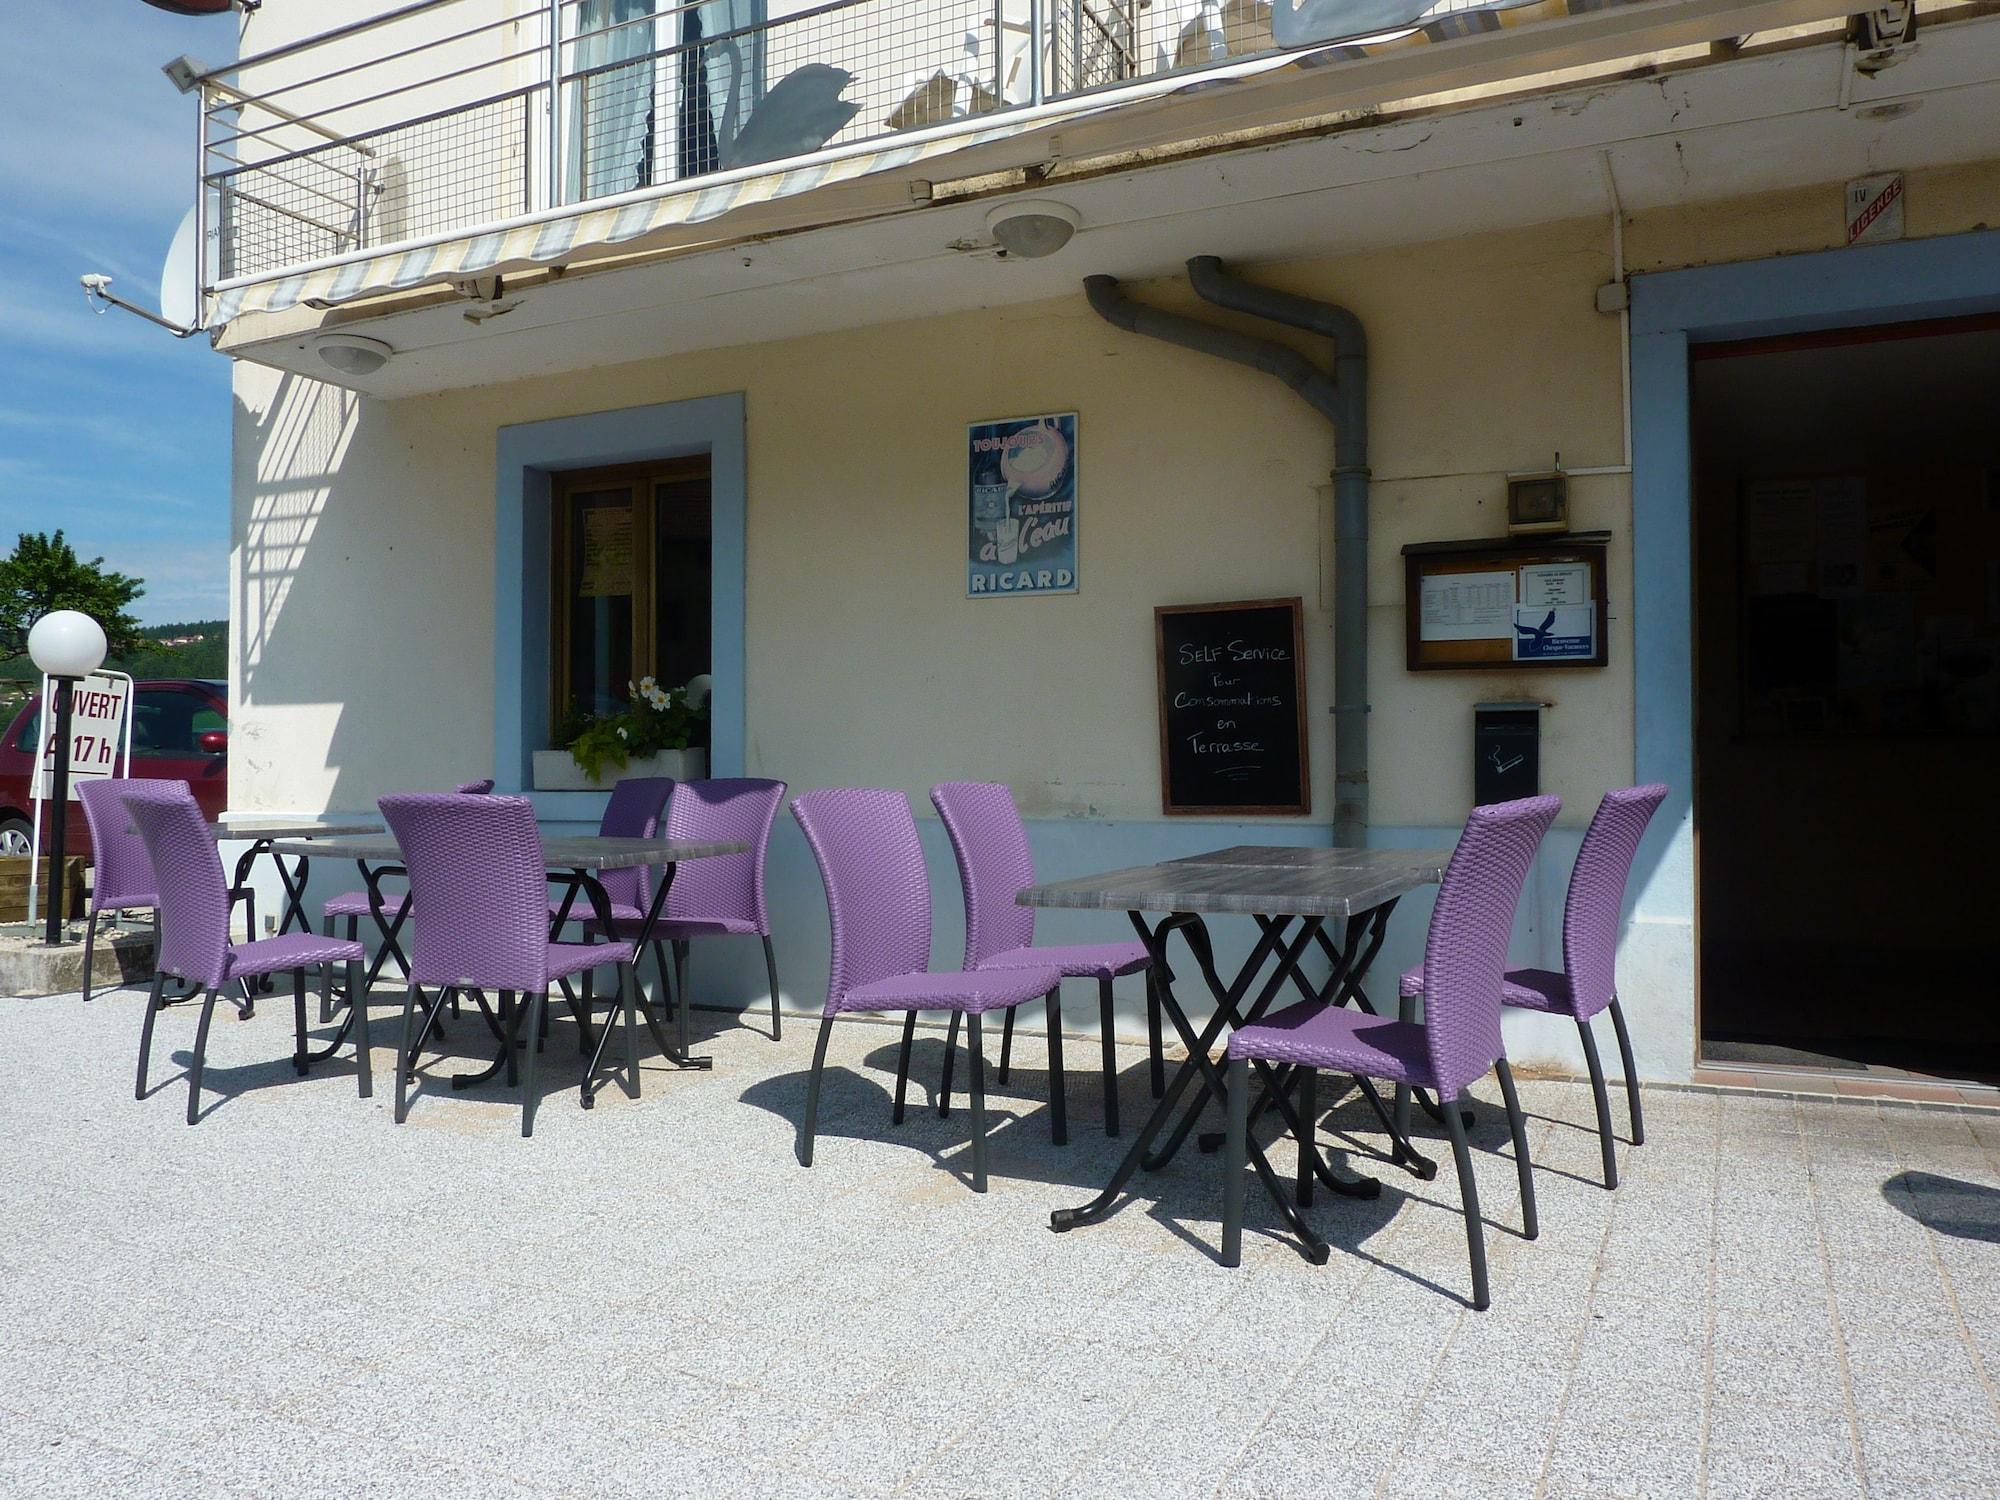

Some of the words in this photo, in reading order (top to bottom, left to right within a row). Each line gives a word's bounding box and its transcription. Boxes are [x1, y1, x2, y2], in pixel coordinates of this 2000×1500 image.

[1855, 188, 1866, 203] IV
[1849, 182, 1902, 241] LICENCE
[973, 433, 1045, 453] TOUJOURS
[971, 568, 1074, 592] RICARD
[1227, 639, 1291, 662] Service
[1174, 691, 1282, 709] Consommations
[1217, 719, 1237, 730] en
[74, 735, 95, 762] 17
[98, 737, 112, 763] h
[1186, 731, 1265, 754] Terrasse
